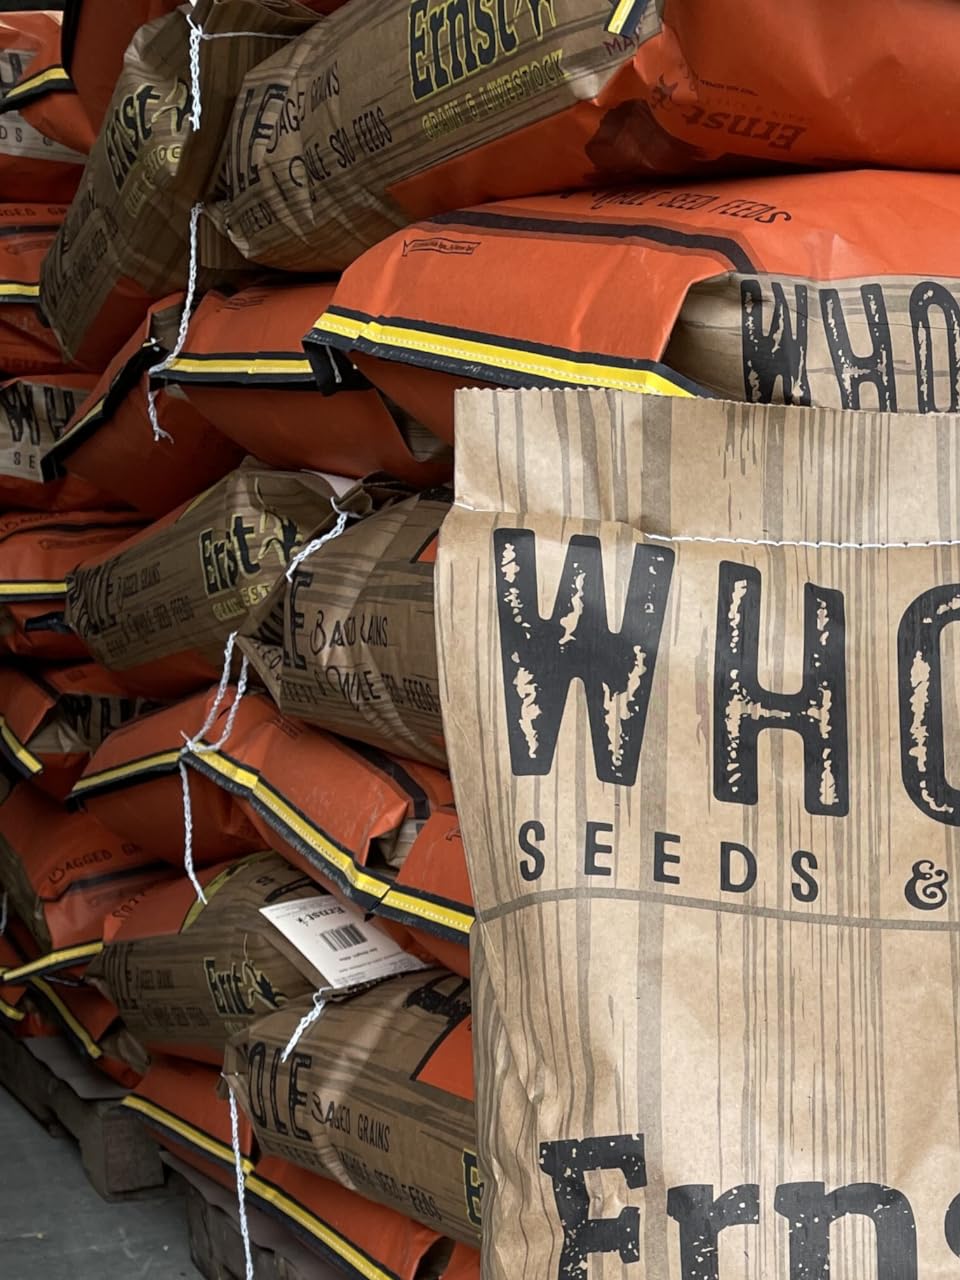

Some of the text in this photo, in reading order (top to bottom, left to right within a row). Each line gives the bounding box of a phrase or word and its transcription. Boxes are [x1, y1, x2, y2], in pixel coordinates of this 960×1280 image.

[479, 50, 569, 112] LIVESTOCK
[713, 199, 793, 225] FEEDS
[517, 820, 820, 903] SEEDS
[904, 859, 949, 911] &
[357, 1113, 392, 1152] GRAINS
